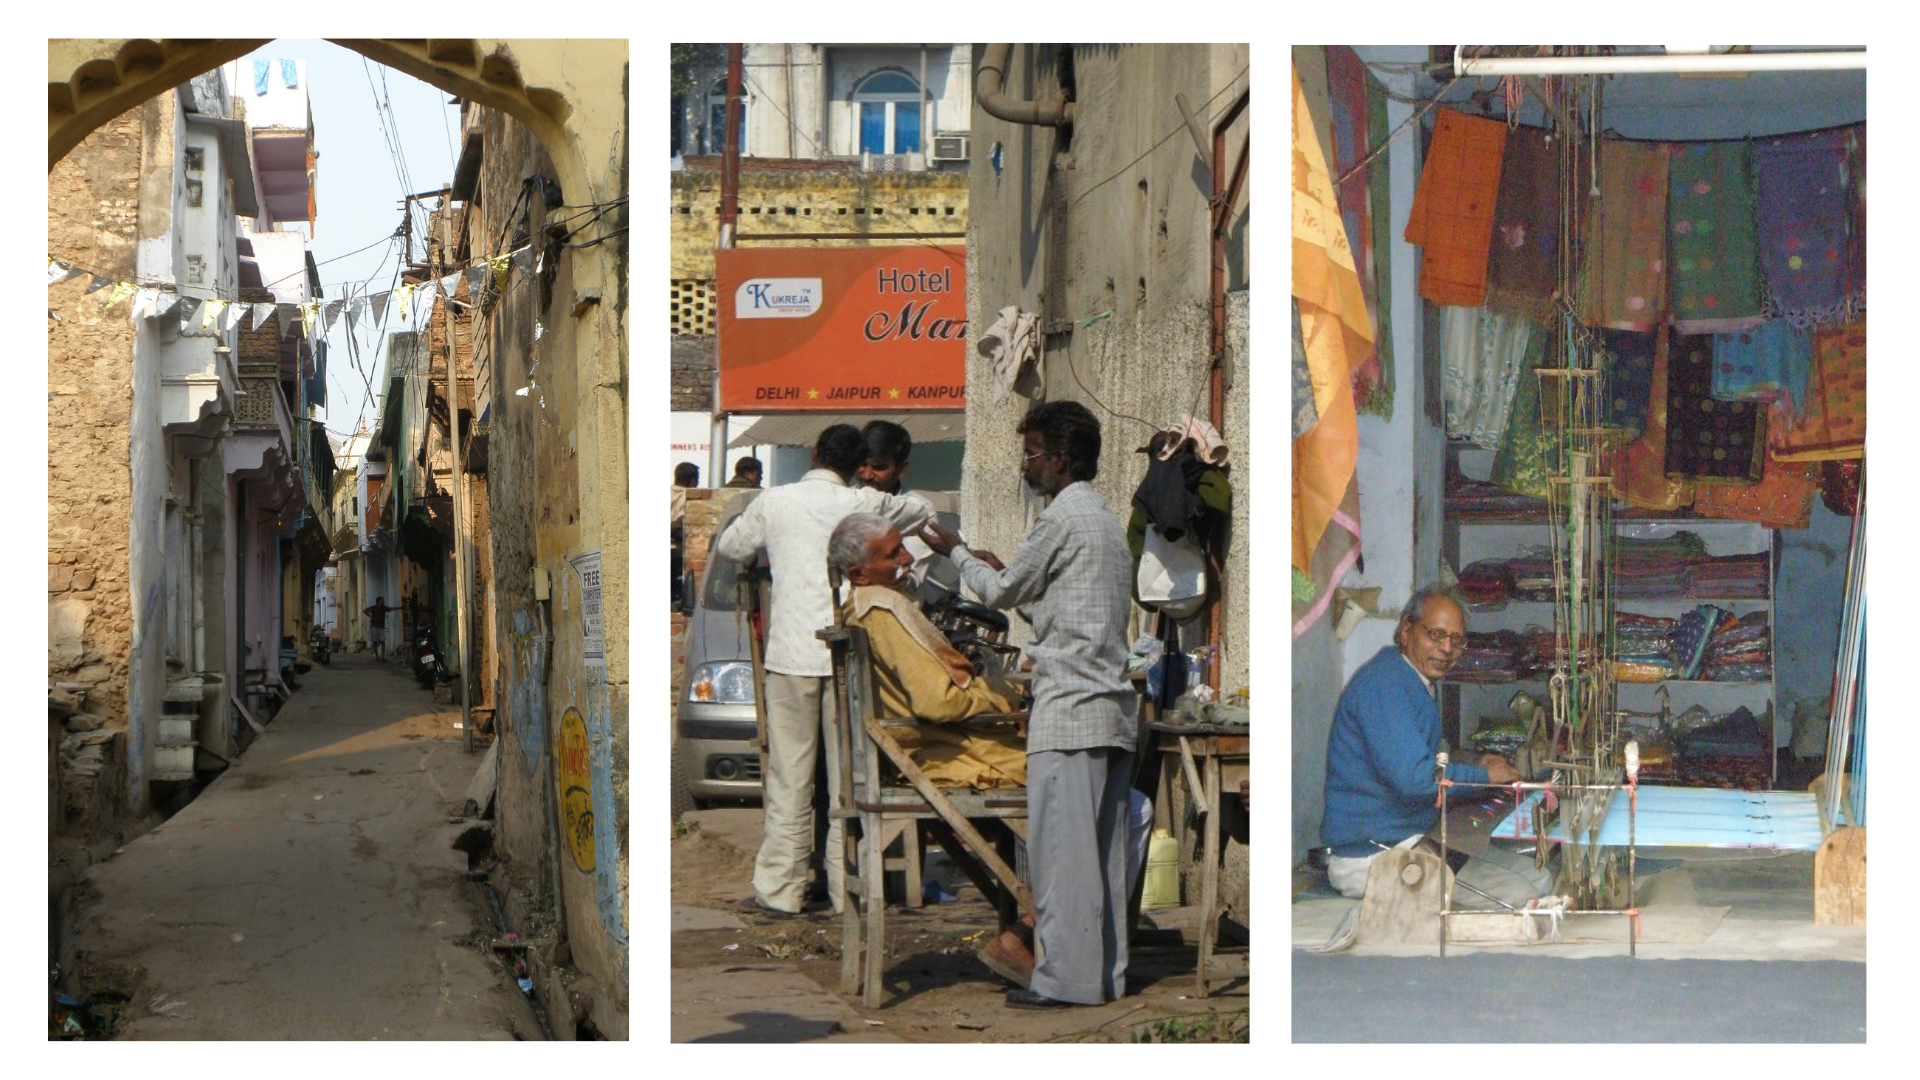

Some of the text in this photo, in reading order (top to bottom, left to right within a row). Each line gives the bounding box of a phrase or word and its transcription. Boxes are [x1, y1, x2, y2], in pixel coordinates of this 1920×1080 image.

[878, 267, 950, 294] Hotel
[755, 386, 800, 400] DELHI
[826, 386, 881, 400] JAIPUR
[583, 570, 600, 587] FREE
[583, 588, 601, 601] COMPUTER
[585, 603, 600, 616] COURSE
